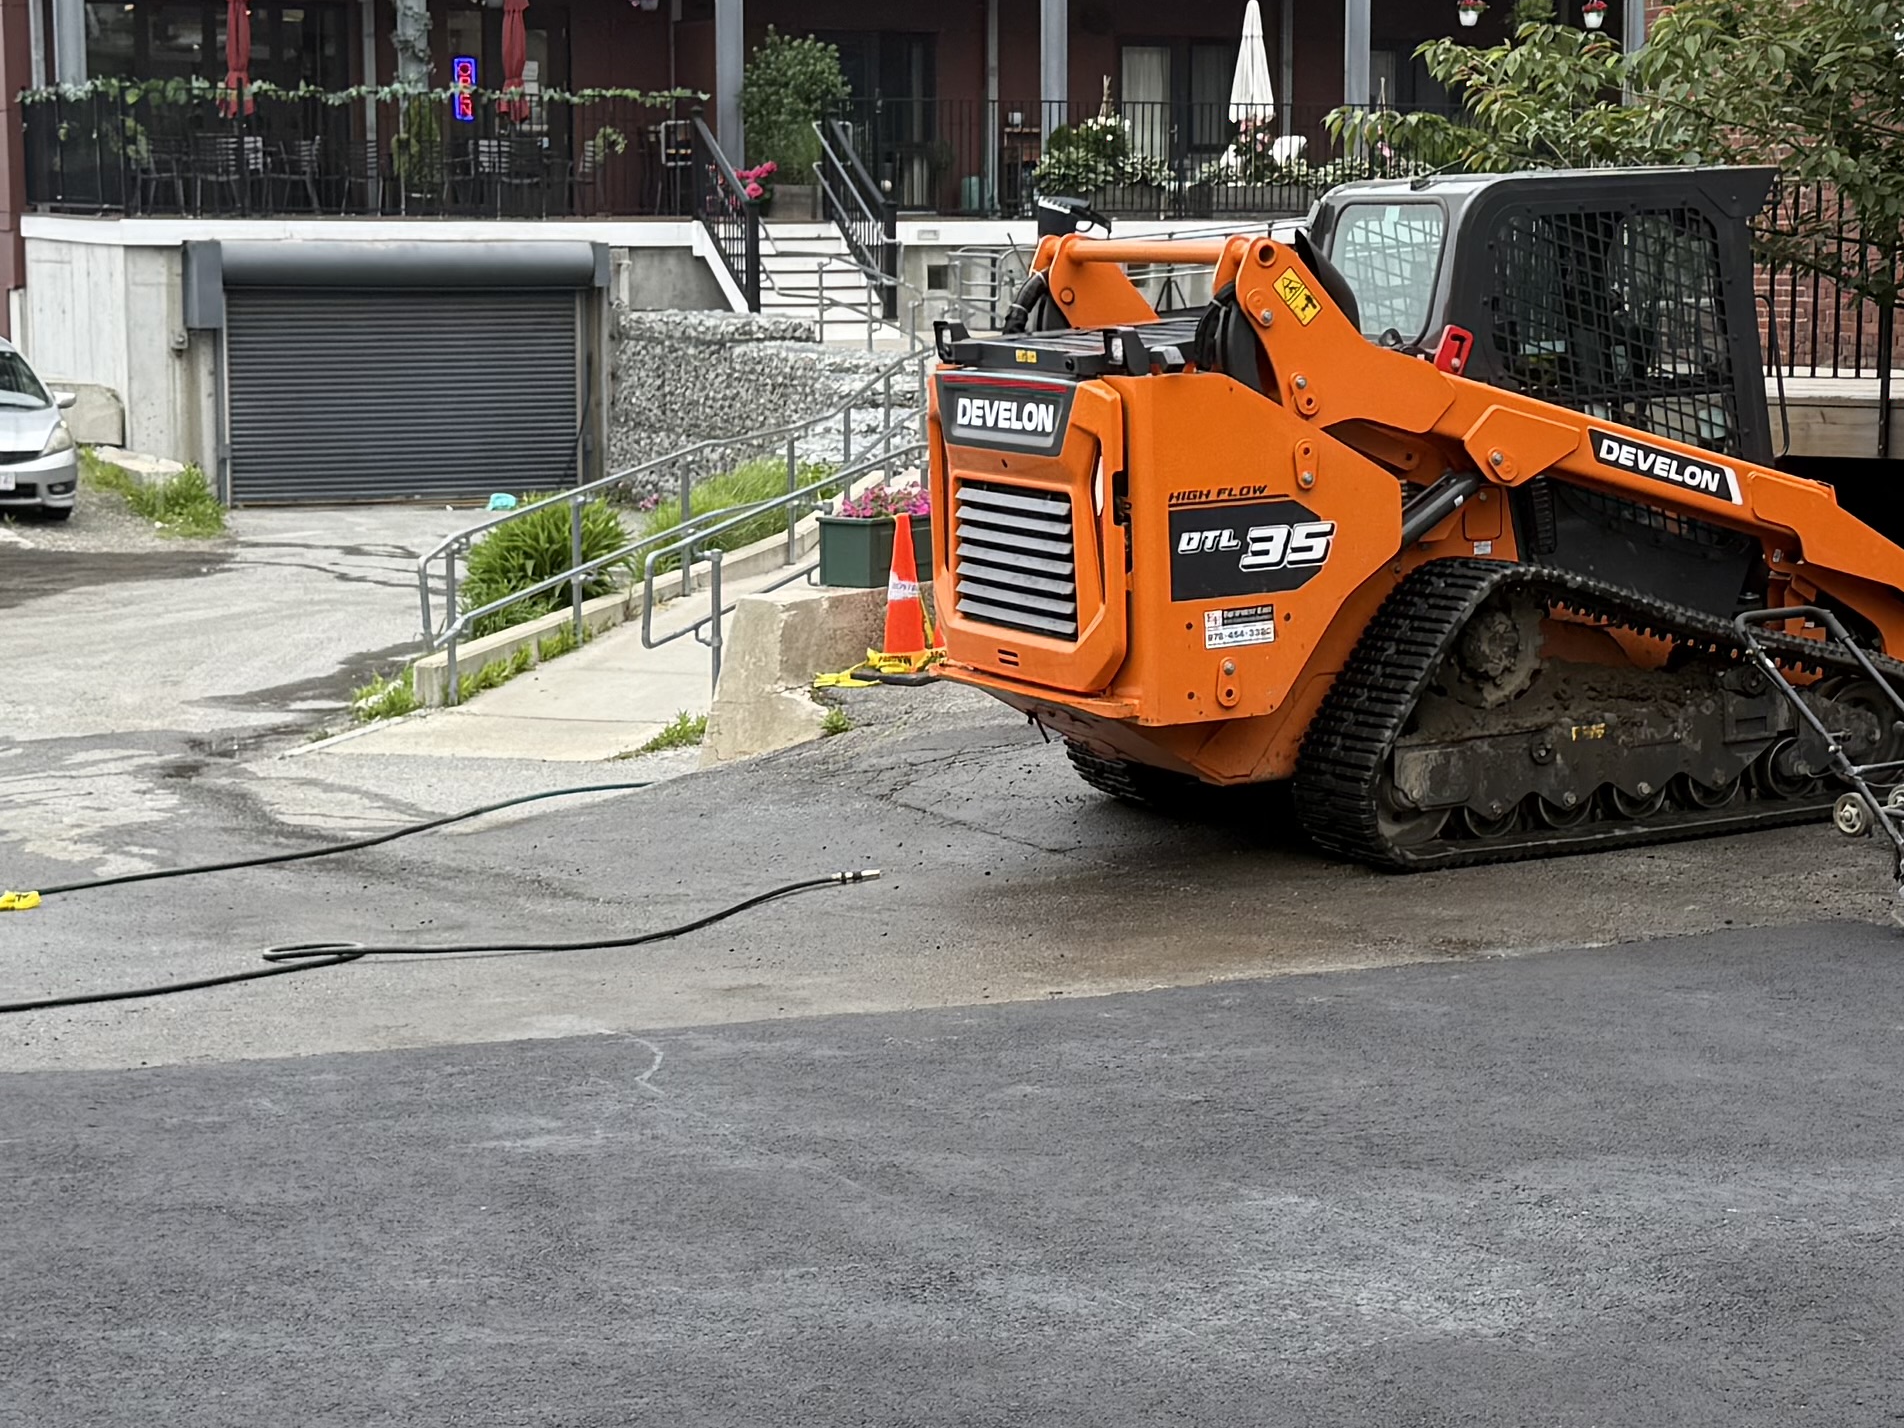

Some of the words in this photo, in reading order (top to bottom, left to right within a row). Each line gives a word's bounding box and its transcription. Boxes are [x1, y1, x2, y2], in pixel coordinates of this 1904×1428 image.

[458, 62, 472, 117] OPEN
[957, 397, 1055, 433] DEVELON
[1599, 438, 1720, 492] DEVELON
[1168, 489, 1211, 503] HIGH
[1217, 485, 1268, 498] FLOW
[1178, 528, 1241, 554] DTL
[1239, 520, 1337, 572] 35
